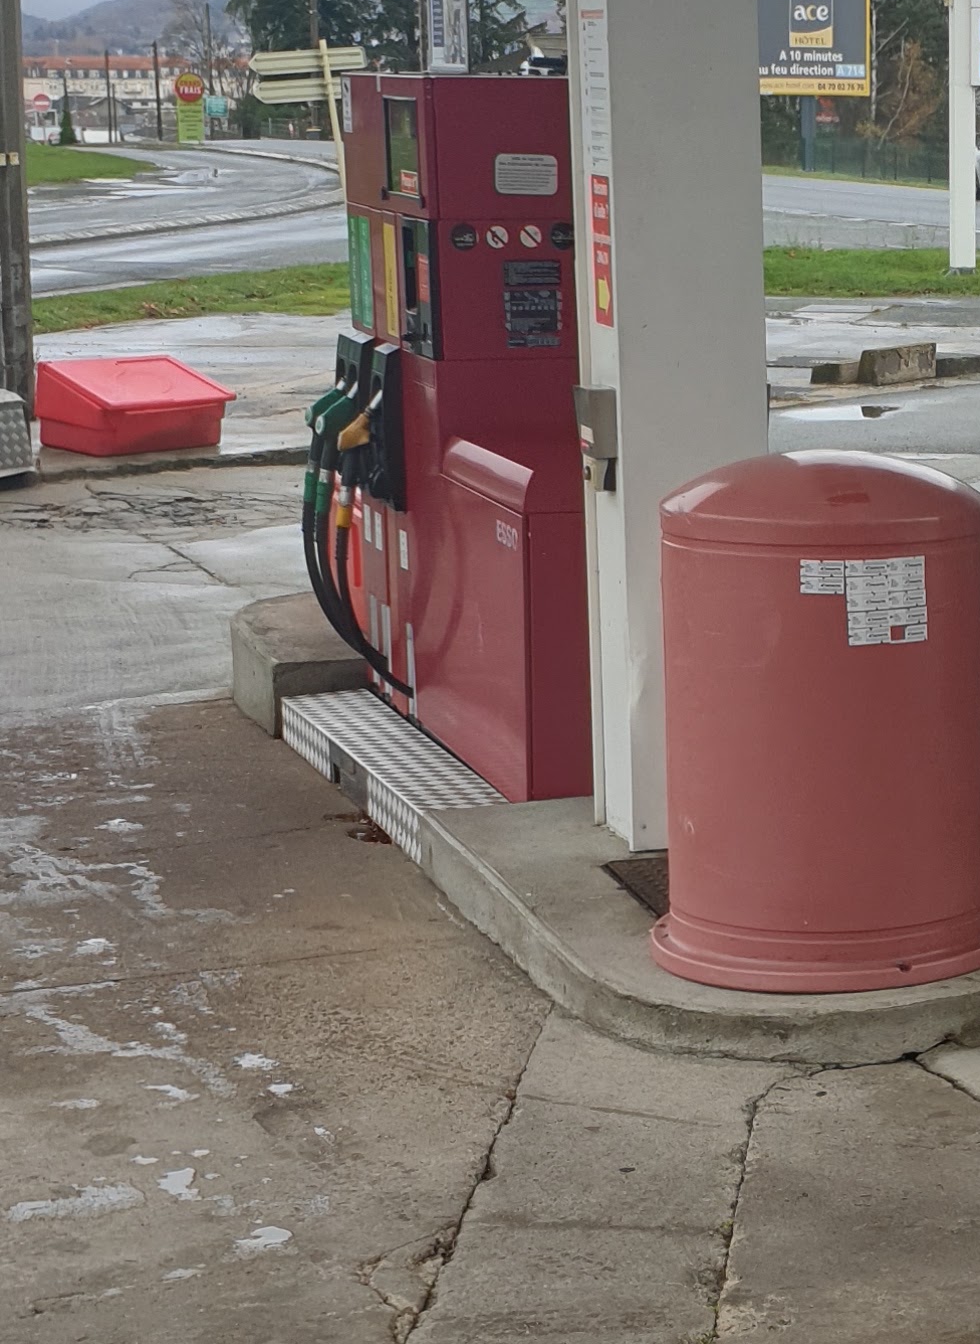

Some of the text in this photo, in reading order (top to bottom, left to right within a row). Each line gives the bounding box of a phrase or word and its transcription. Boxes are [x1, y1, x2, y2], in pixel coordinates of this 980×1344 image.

[793, 4, 829, 22] ace
[779, 50, 843, 62] A 10 minutes
[771, 63, 788, 75] feu
[790, 64, 834, 76] direction
